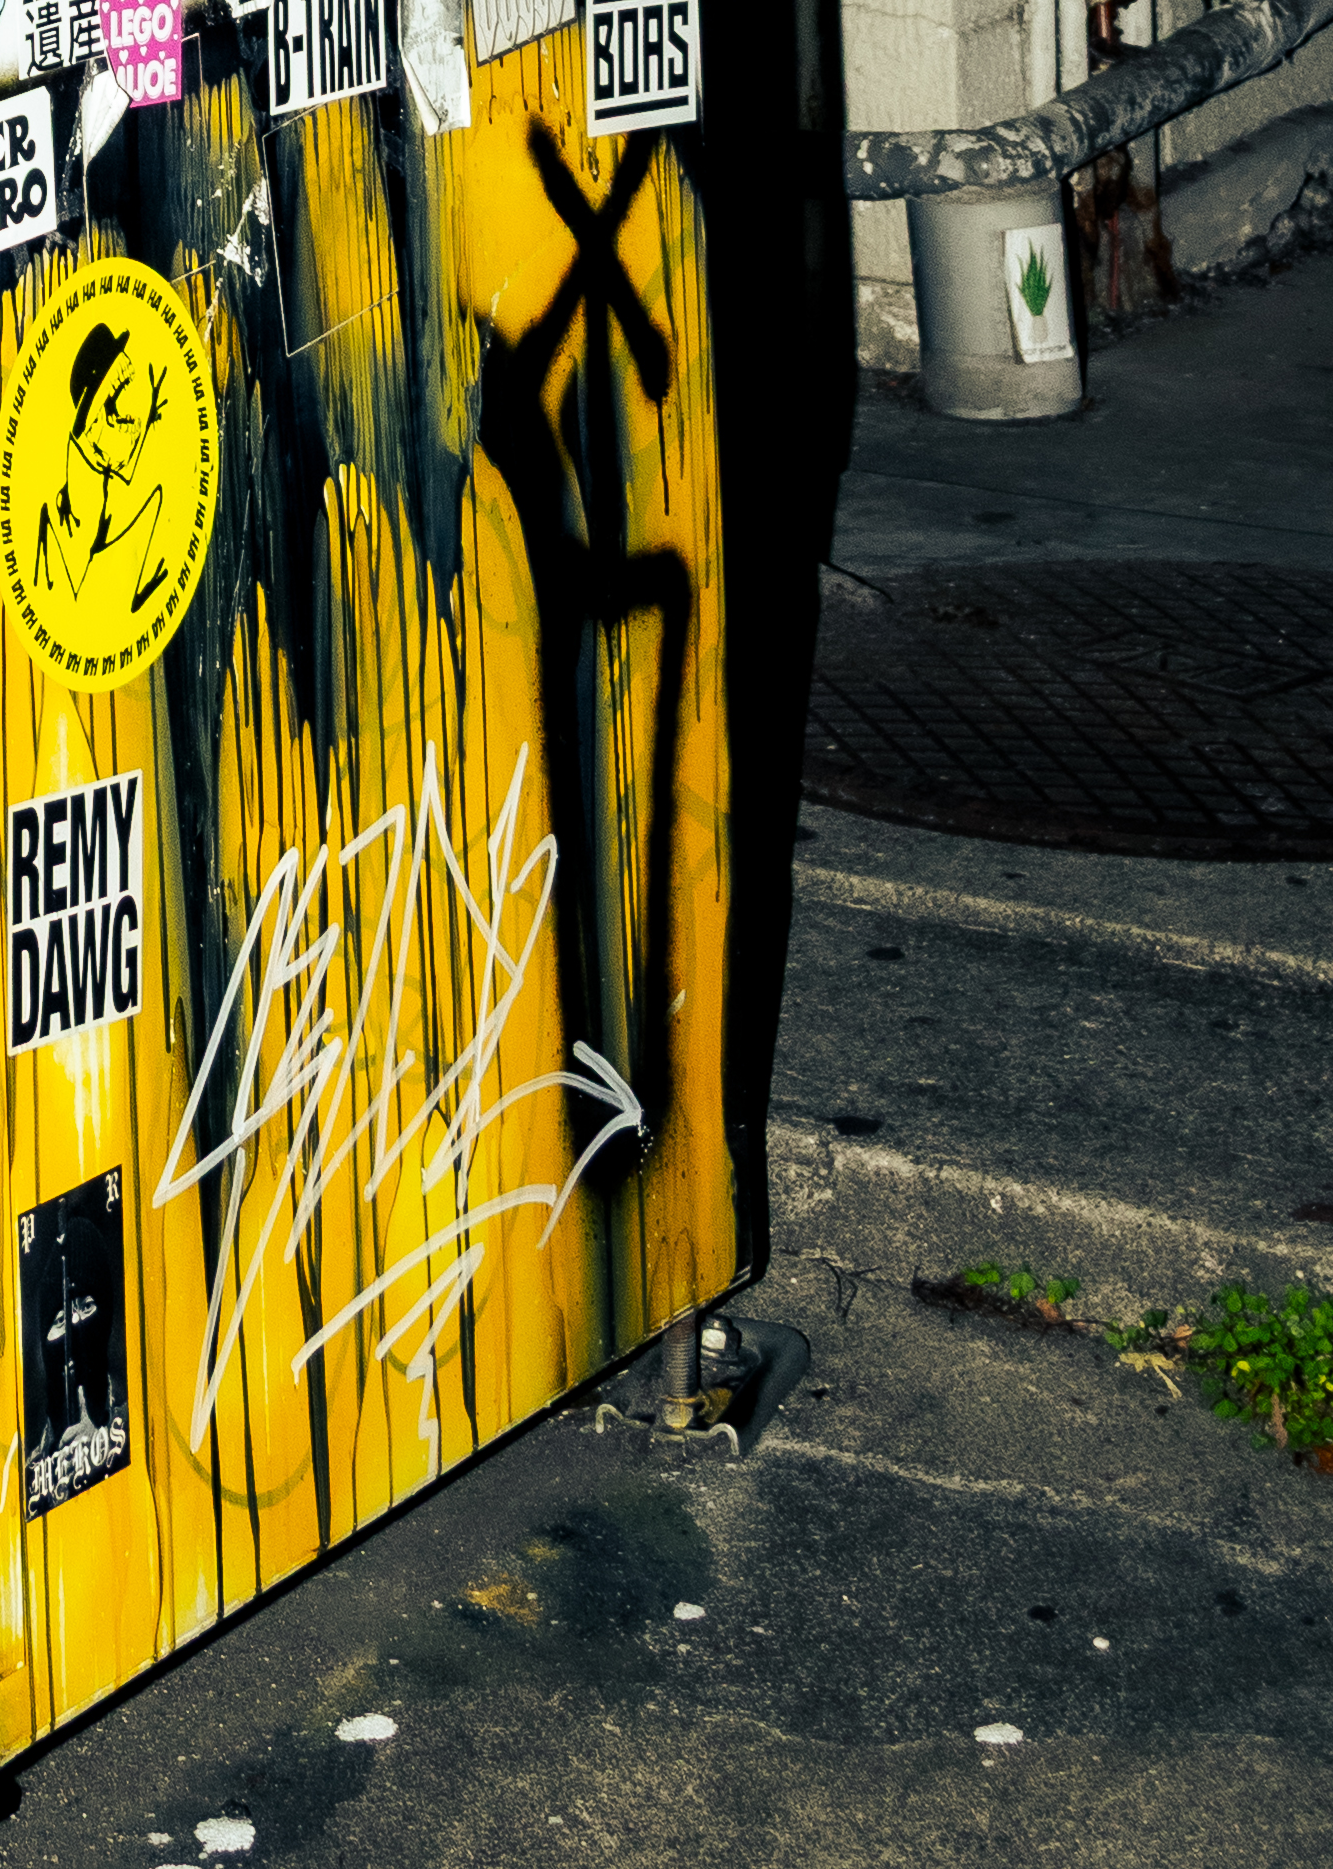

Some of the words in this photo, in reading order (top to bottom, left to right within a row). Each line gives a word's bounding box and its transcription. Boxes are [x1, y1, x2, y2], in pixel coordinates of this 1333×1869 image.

[110, 3, 174, 49] LEGO
[594, 1, 689, 101] BOAS
[100, 274, 113, 295] HA
[14, 786, 137, 923] REMY
[12, 895, 139, 1048] DAWG
